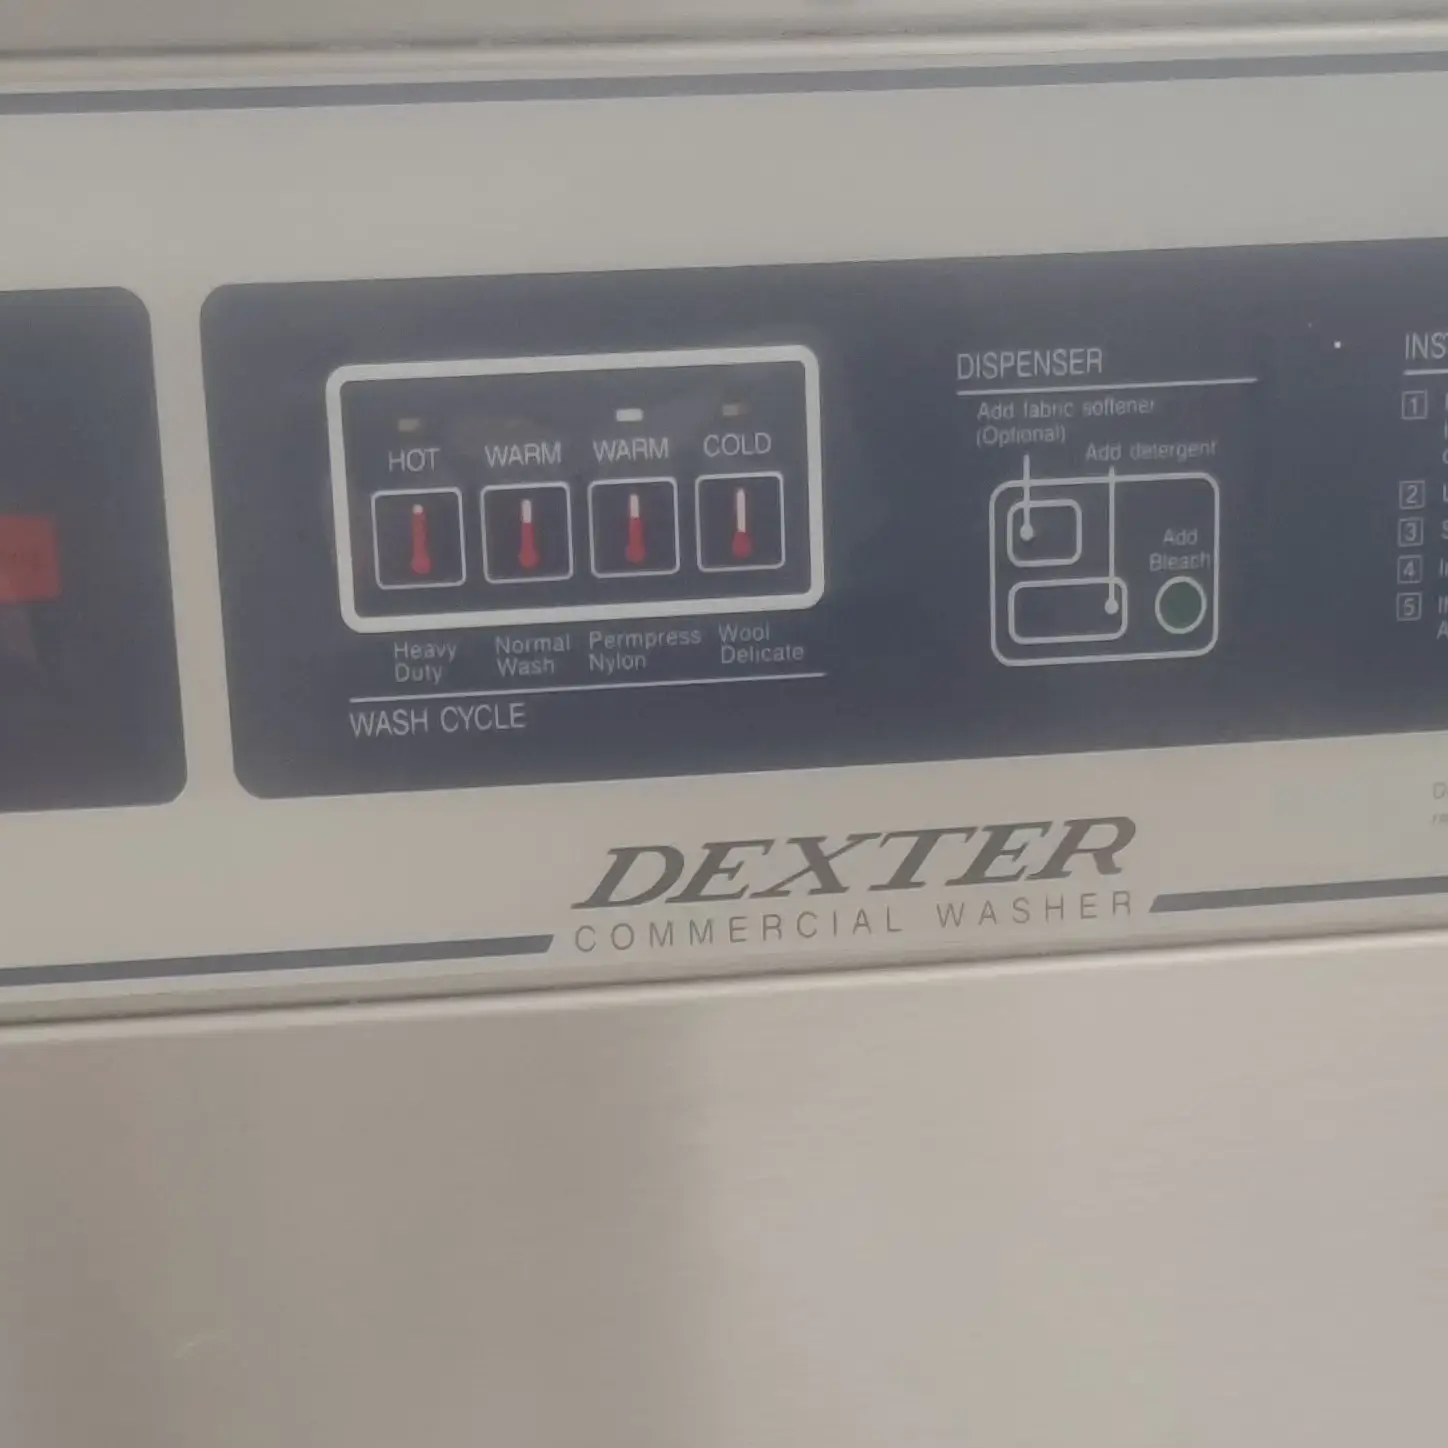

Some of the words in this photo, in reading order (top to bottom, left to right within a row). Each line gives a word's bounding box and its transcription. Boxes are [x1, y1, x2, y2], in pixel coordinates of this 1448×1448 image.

[957, 348, 1103, 381] DISPENSER
[977, 400, 1015, 421] Add
[1022, 399, 1074, 419] fabric
[1082, 396, 1155, 416] softener
[1408, 396, 1419, 413] 1
[703, 432, 772, 458] COLD
[976, 423, 1067, 448] (Optional)
[388, 447, 441, 473] HOT
[485, 441, 562, 467] WARM
[593, 437, 670, 463] WARM
[1085, 441, 1122, 461] Add
[1129, 438, 1218, 464] detergent
[1405, 483, 1419, 505] 2
[1163, 527, 1198, 546] Add
[1404, 521, 1417, 543] 3
[1149, 550, 1212, 572] Bleach
[1402, 559, 1415, 580] 4
[1403, 597, 1415, 617] 5
[495, 633, 571, 655] Normal
[588, 626, 702, 652] Permpress
[717, 622, 771, 643] Wool
[393, 639, 457, 664] Heavy
[588, 650, 647, 676] Nylon
[720, 642, 805, 666] Delicate
[394, 662, 443, 686] Duty
[497, 656, 555, 676] Wash
[349, 709, 429, 738] WASH
[439, 702, 527, 733] CYCLE
[571, 815, 1138, 910] DEXTER
[574, 904, 902, 954] COMMERCIAL
[937, 891, 1134, 930] WASHER
